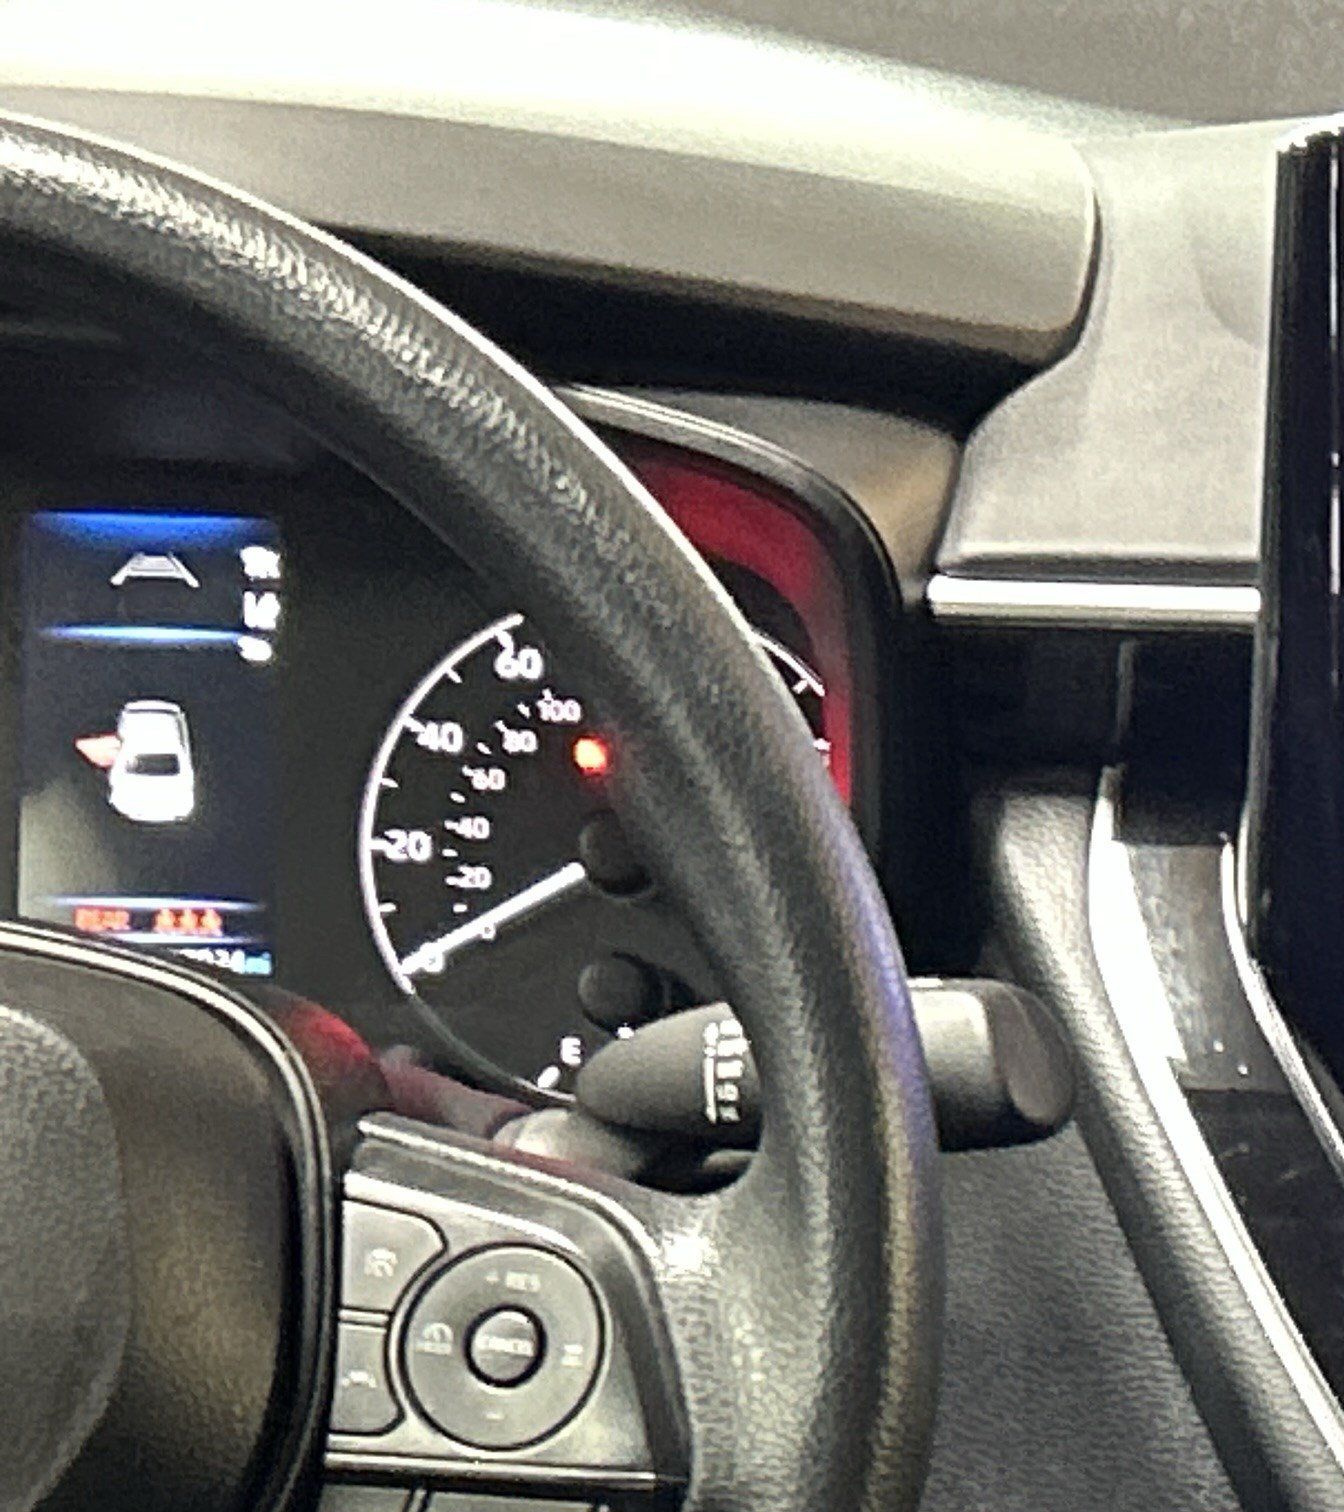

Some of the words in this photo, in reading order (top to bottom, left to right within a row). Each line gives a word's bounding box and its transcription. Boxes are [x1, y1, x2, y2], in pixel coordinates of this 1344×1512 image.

[496, 648, 543, 679] 60
[538, 699, 581, 722] 100
[416, 724, 464, 752] 40
[505, 730, 538, 752] 80
[471, 768, 506, 790] 60
[456, 818, 490, 839] 40
[386, 830, 432, 862] 20
[456, 868, 492, 890] 20
[560, 1036, 582, 1064] E
